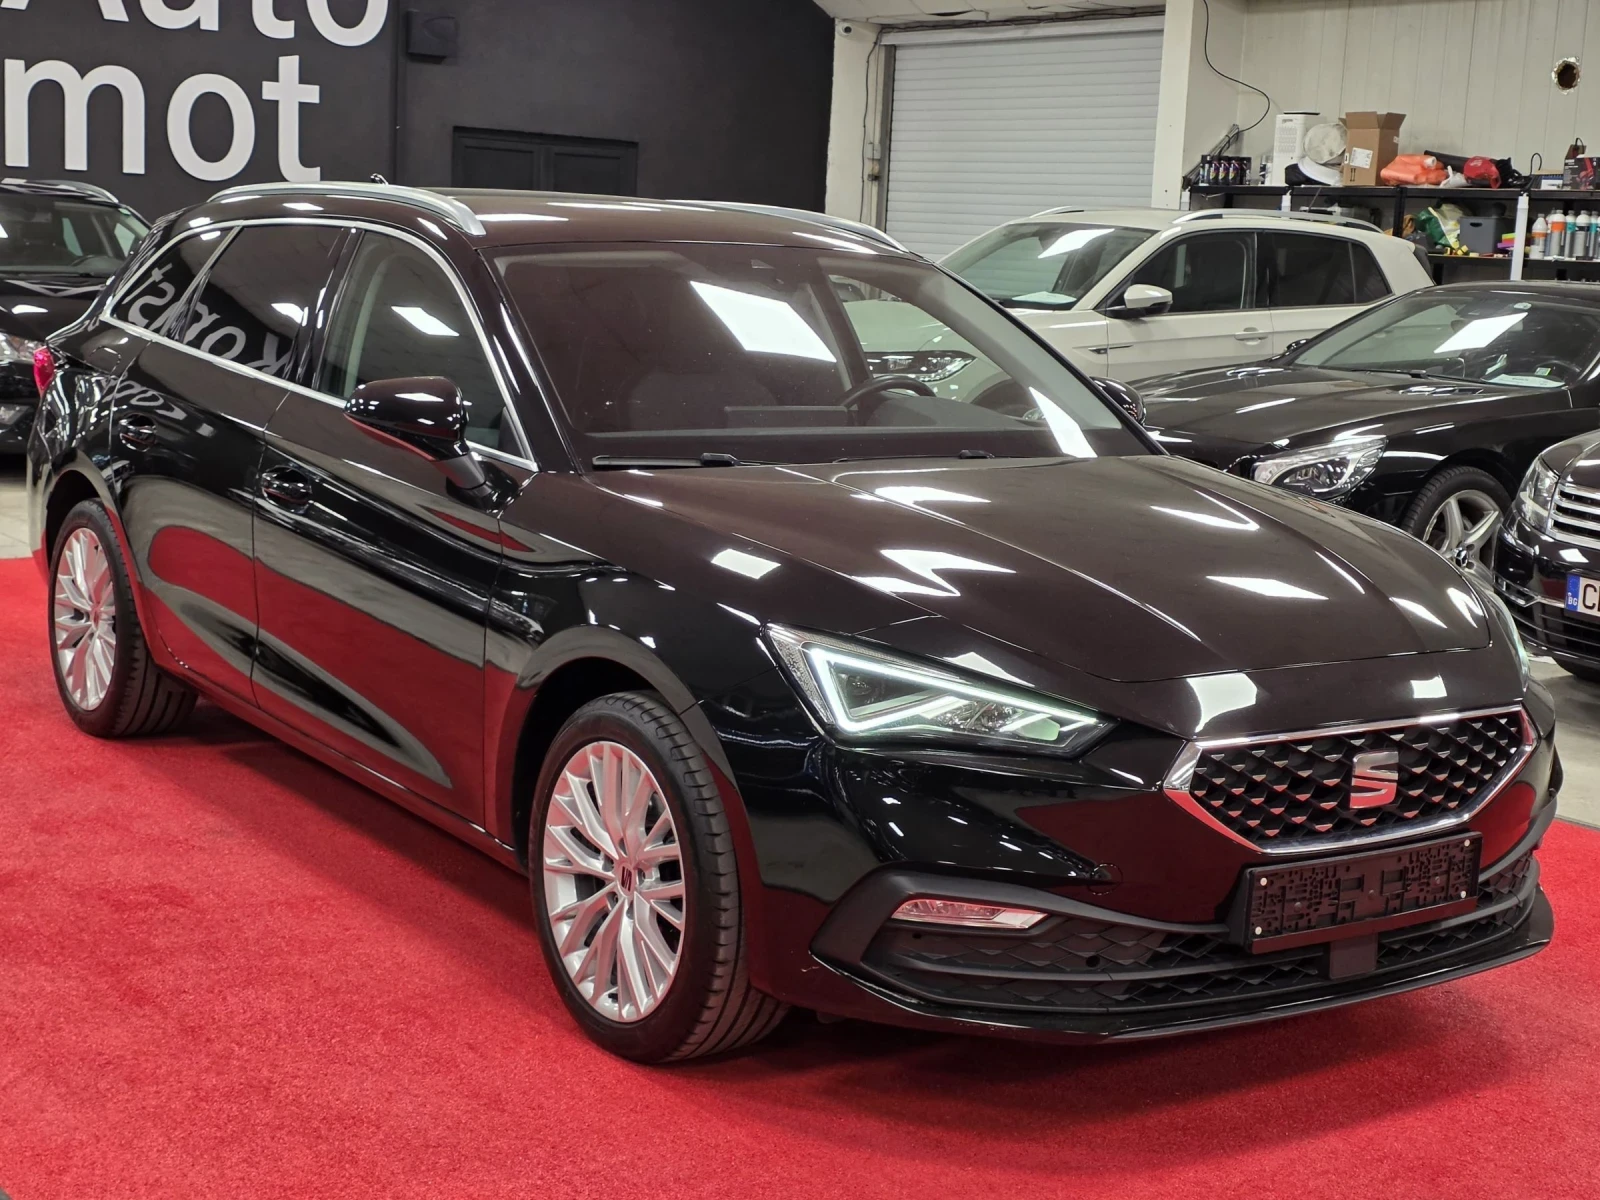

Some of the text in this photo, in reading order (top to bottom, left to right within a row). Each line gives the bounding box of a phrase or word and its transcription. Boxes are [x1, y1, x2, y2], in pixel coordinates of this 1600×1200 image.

[4, 55, 321, 182] mot
[1568, 597, 1578, 606] BG
[1582, 583, 1600, 612] C
